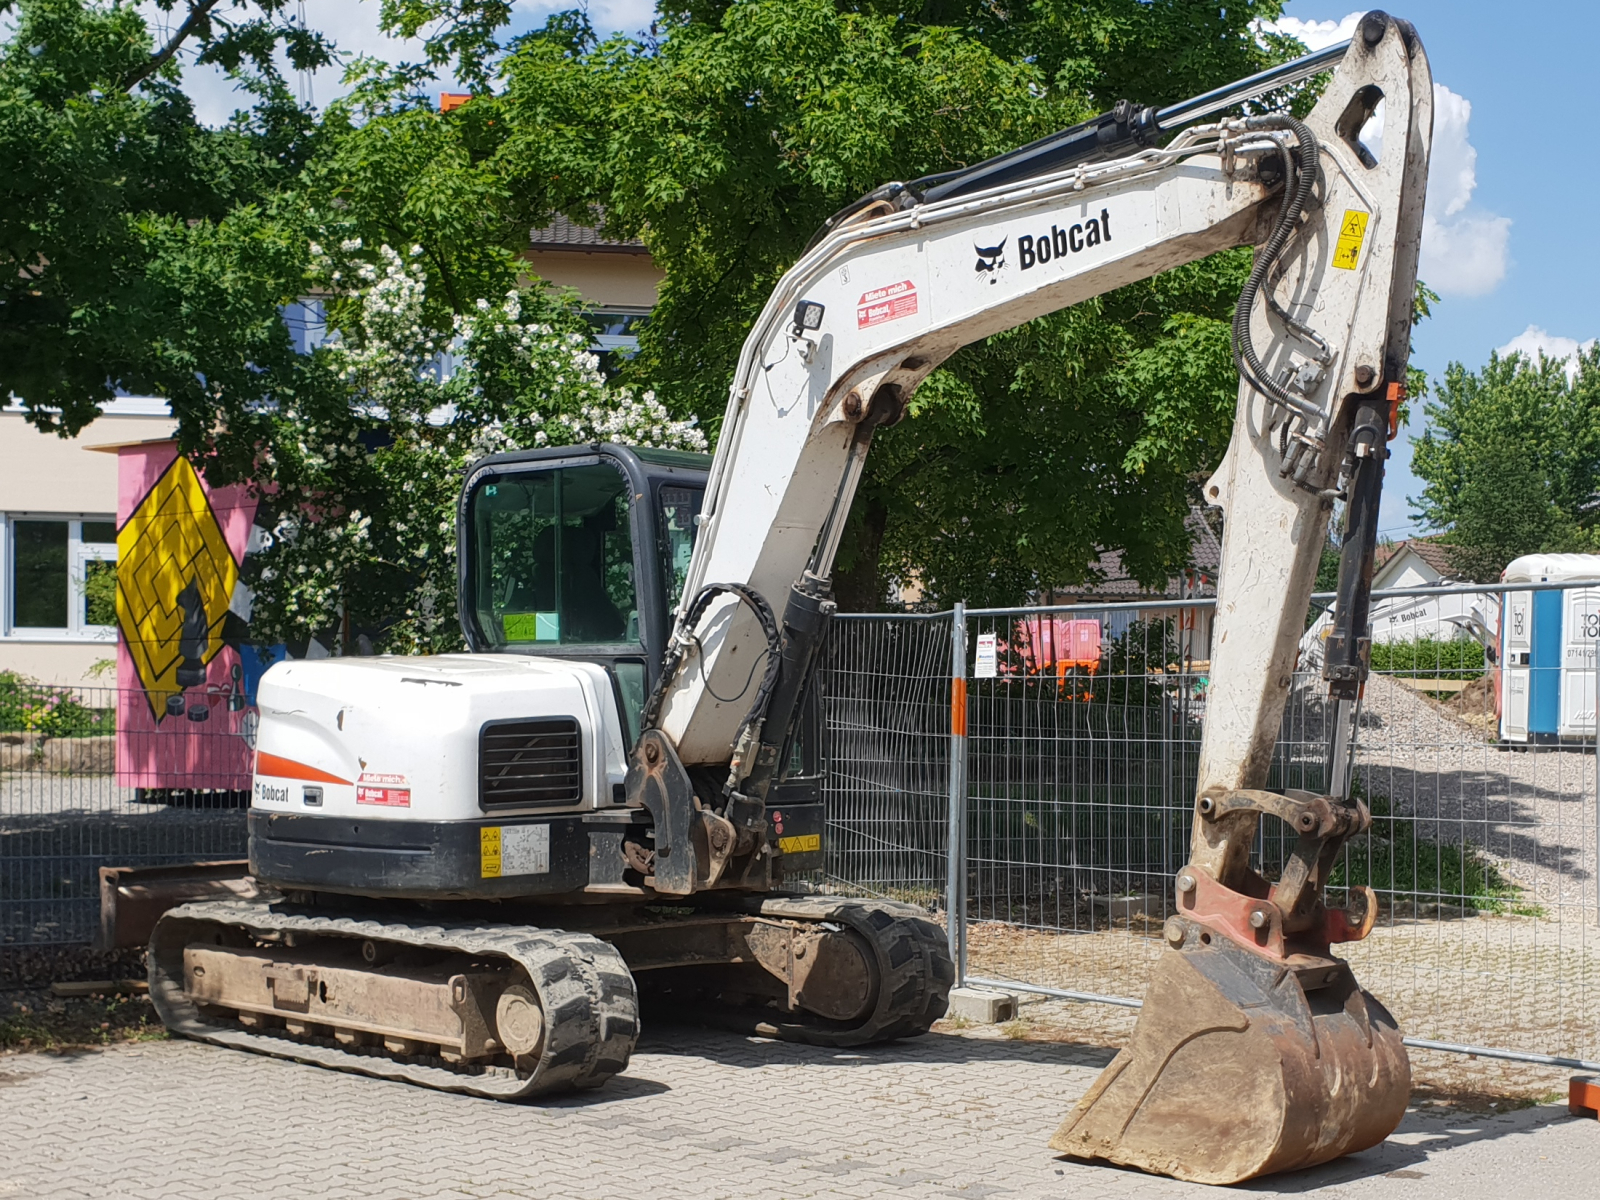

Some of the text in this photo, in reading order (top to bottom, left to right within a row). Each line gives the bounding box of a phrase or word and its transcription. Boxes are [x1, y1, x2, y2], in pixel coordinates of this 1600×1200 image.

[1018, 208, 1112, 271] Bobcat
[864, 282, 908, 302] Miete mich
[868, 304, 890, 318] Bobcat
[1401, 608, 1427, 623] Bobcat
[1514, 624, 1524, 636] TOI
[262, 784, 289, 803] Bobcat
